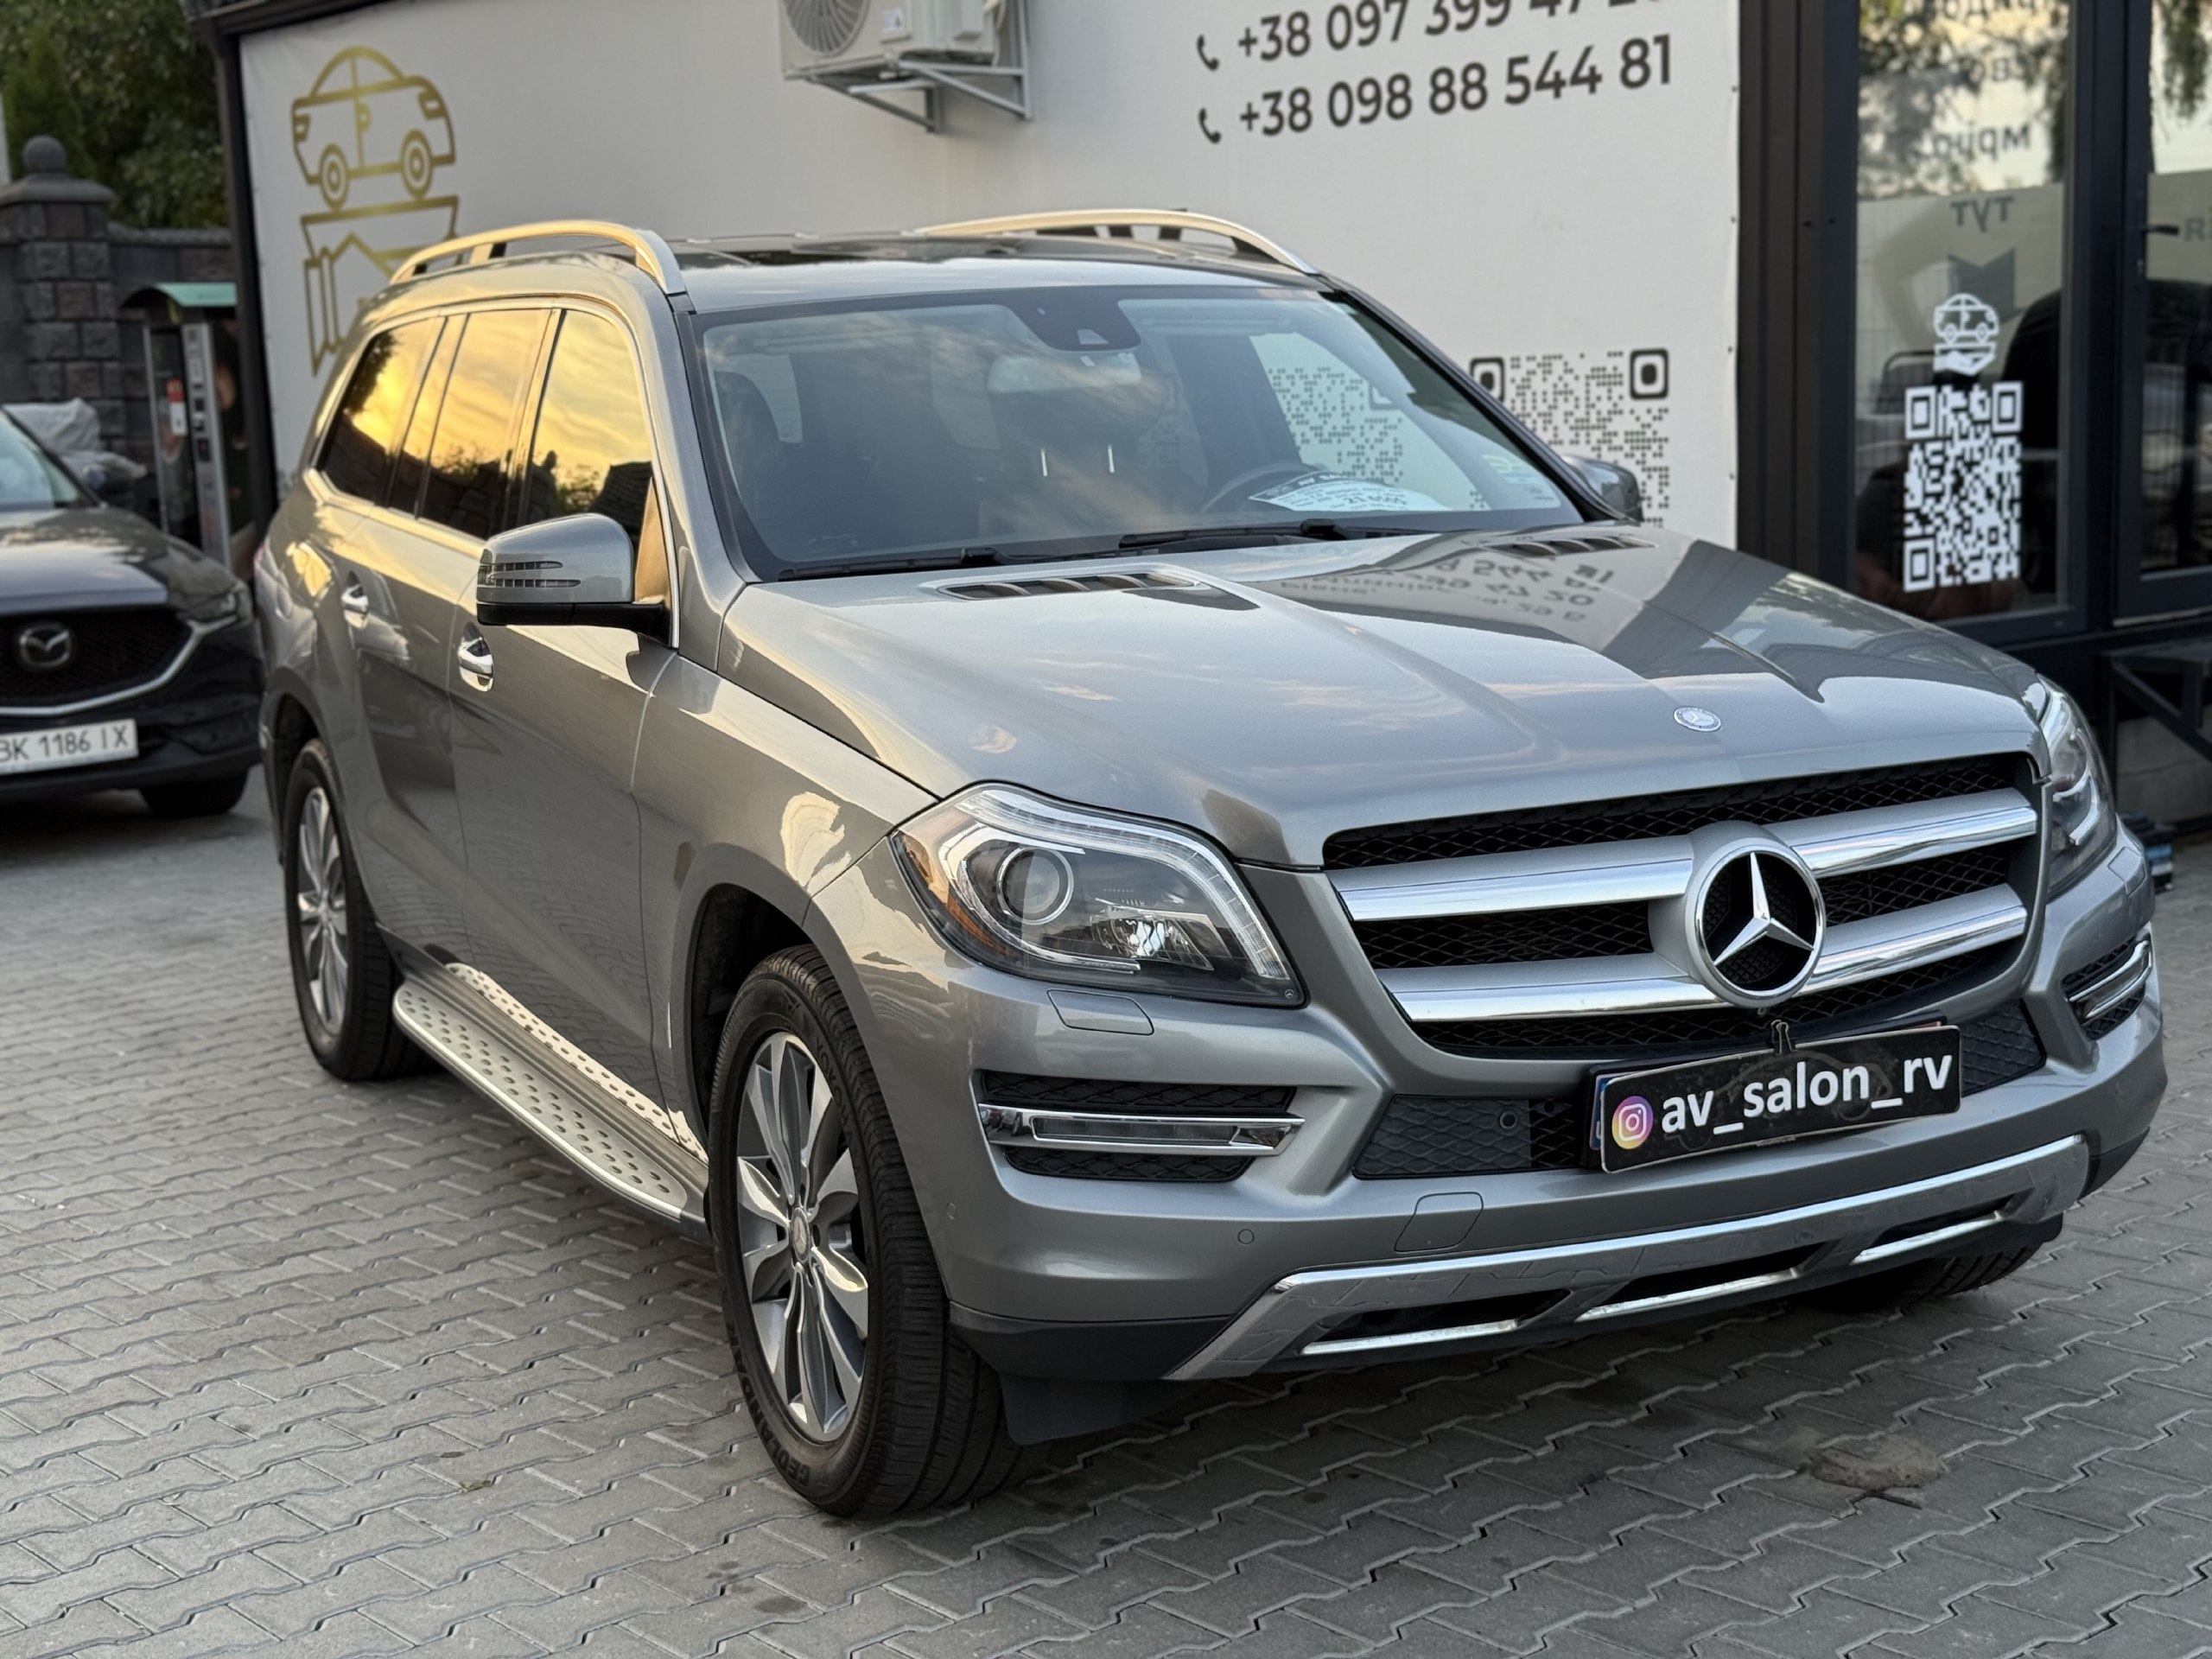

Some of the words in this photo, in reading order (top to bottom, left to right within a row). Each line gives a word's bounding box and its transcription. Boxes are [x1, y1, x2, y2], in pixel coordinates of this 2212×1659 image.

[1237, 11, 1311, 61] +38
[1325, 0, 1410, 50] 097
[1239, 87, 1313, 137] +38
[1327, 73, 1414, 128] 098
[1428, 63, 1489, 115] 88
[1504, 46, 1603, 105] 544
[1619, 34, 1671, 89] 81
[38, 729, 92, 758] 1186
[1661, 1054, 1953, 1135] av_salon_rv
[727, 1320, 810, 1486] GEOLANDAR
